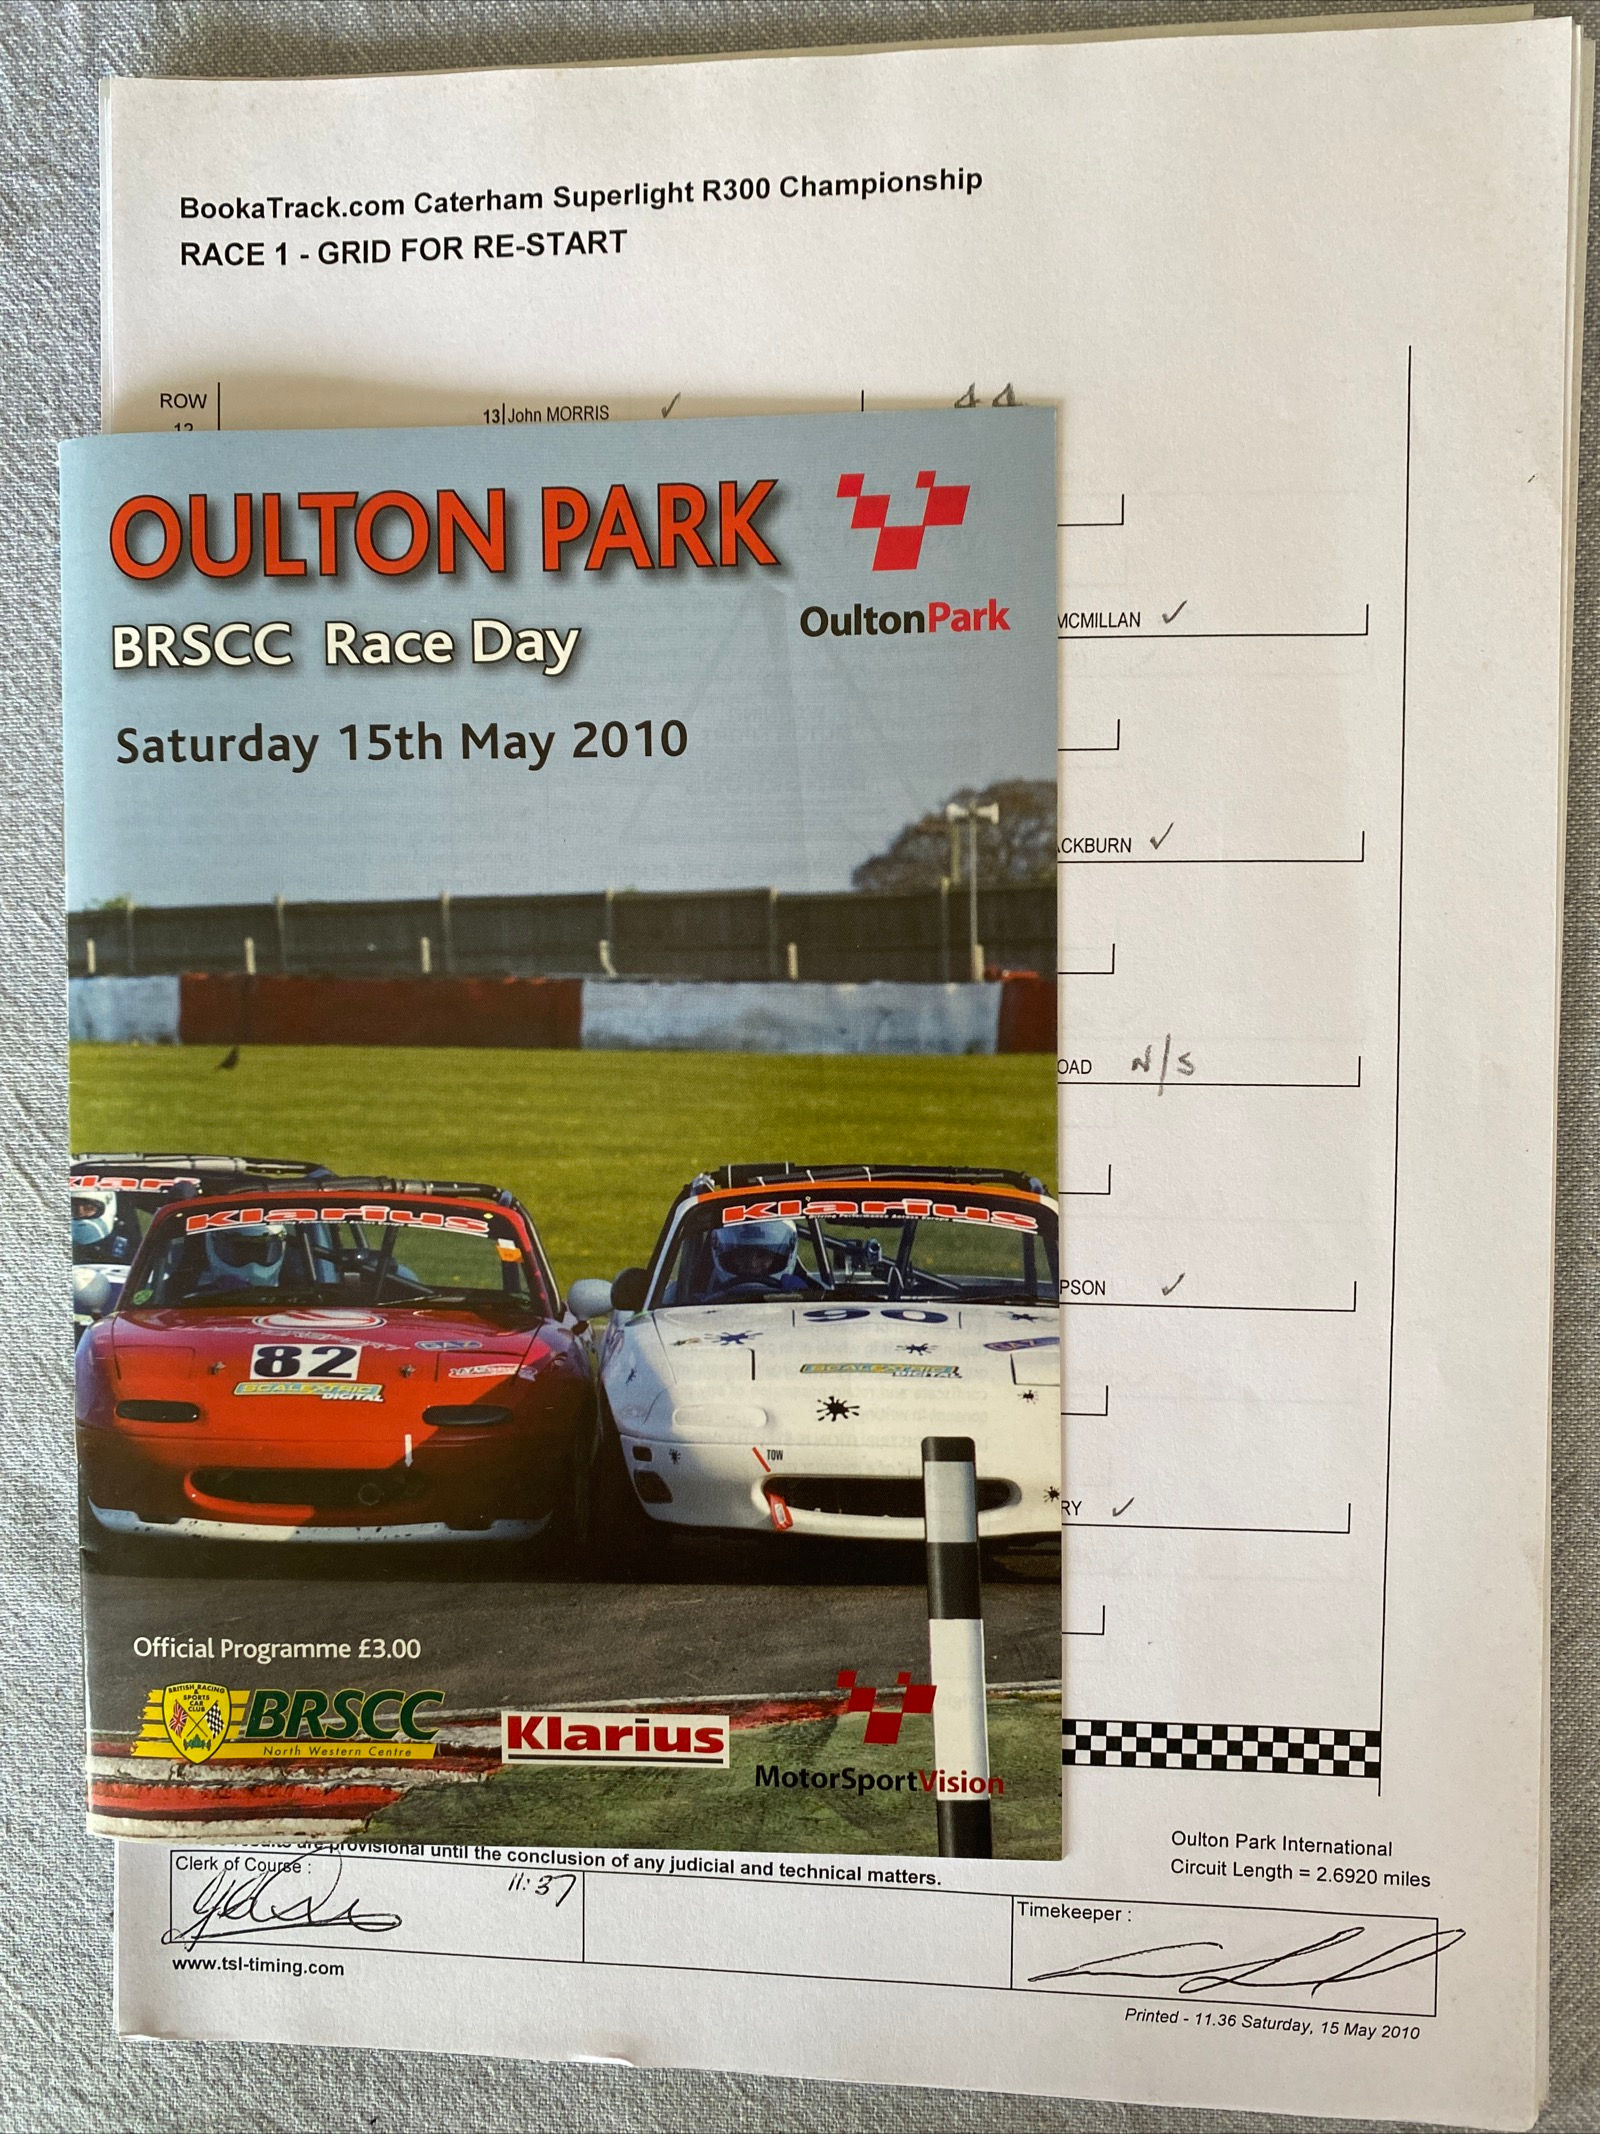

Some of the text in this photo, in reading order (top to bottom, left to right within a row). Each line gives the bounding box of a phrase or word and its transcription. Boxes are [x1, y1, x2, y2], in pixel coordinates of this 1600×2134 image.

[181, 168, 983, 219] BookaTrack.com Caterham Superlight R300 Championship
[181, 242, 265, 266] RACE
[275, 242, 287, 265] 1
[318, 239, 391, 265] GRID
[401, 237, 464, 262] FOR
[474, 230, 628, 259] RE-START
[160, 393, 207, 409] ROW
[483, 405, 610, 424] 13 John MORRIS
[109, 479, 781, 580] OULTON PARK
[800, 598, 1011, 637] OultonPark
[1057, 611, 1141, 629] MCMILLAN
[113, 618, 582, 676] BRSCC Race Day
[116, 719, 688, 774] Saturday 15th May 2010
[1057, 1059, 1092, 1075] OAD
[185, 1205, 490, 1233] Klarius
[722, 1198, 1039, 1230] Klarius
[1060, 1279, 1106, 1296] PSON
[803, 1309, 949, 1325] 90
[253, 1345, 358, 1379] 82
[321, 1391, 384, 1403] DIGITAL
[766, 1448, 784, 1462] TOW
[133, 1636, 422, 1665] Official Programme £3.00
[168, 1684, 225, 1694] BRITISH RACING
[244, 1689, 446, 1741] BRSCC
[507, 1715, 725, 1754] Klarius
[263, 1745, 413, 1758] North Western Centre
[754, 1765, 1005, 1796] MotorSportVision
[1171, 1830, 1393, 1857] Oulton Park International
[175, 1855, 219, 1871] Clerk
[224, 1857, 241, 1871] of
[244, 1857, 302, 1874] Course
[431, 1845, 469, 1859] until
[475, 1846, 502, 1861] the
[507, 1850, 606, 1869] conclusion
[611, 1853, 629, 1868] of
[633, 1858, 666, 1874] any
[668, 1855, 735, 1874] judicial
[740, 1861, 774, 1877] and
[779, 1862, 862, 1881] technical
[867, 1868, 942, 1886] matters.
[1170, 1859, 1431, 1888] Circuit Length = 2.6920 miles
[508, 1872, 577, 1907] 11:37
[1018, 1901, 1122, 1923] Timekeeper
[172, 1956, 345, 1976] www.tsl-timing.com
[1124, 2007, 1180, 2024] Printed
[1195, 2012, 1237, 2028] 11.36
[1241, 2014, 1314, 2036] Saturday,
[1321, 2021, 1340, 2035] 15
[1343, 2022, 1378, 2040] May
[1381, 2024, 1421, 2040] 2010
